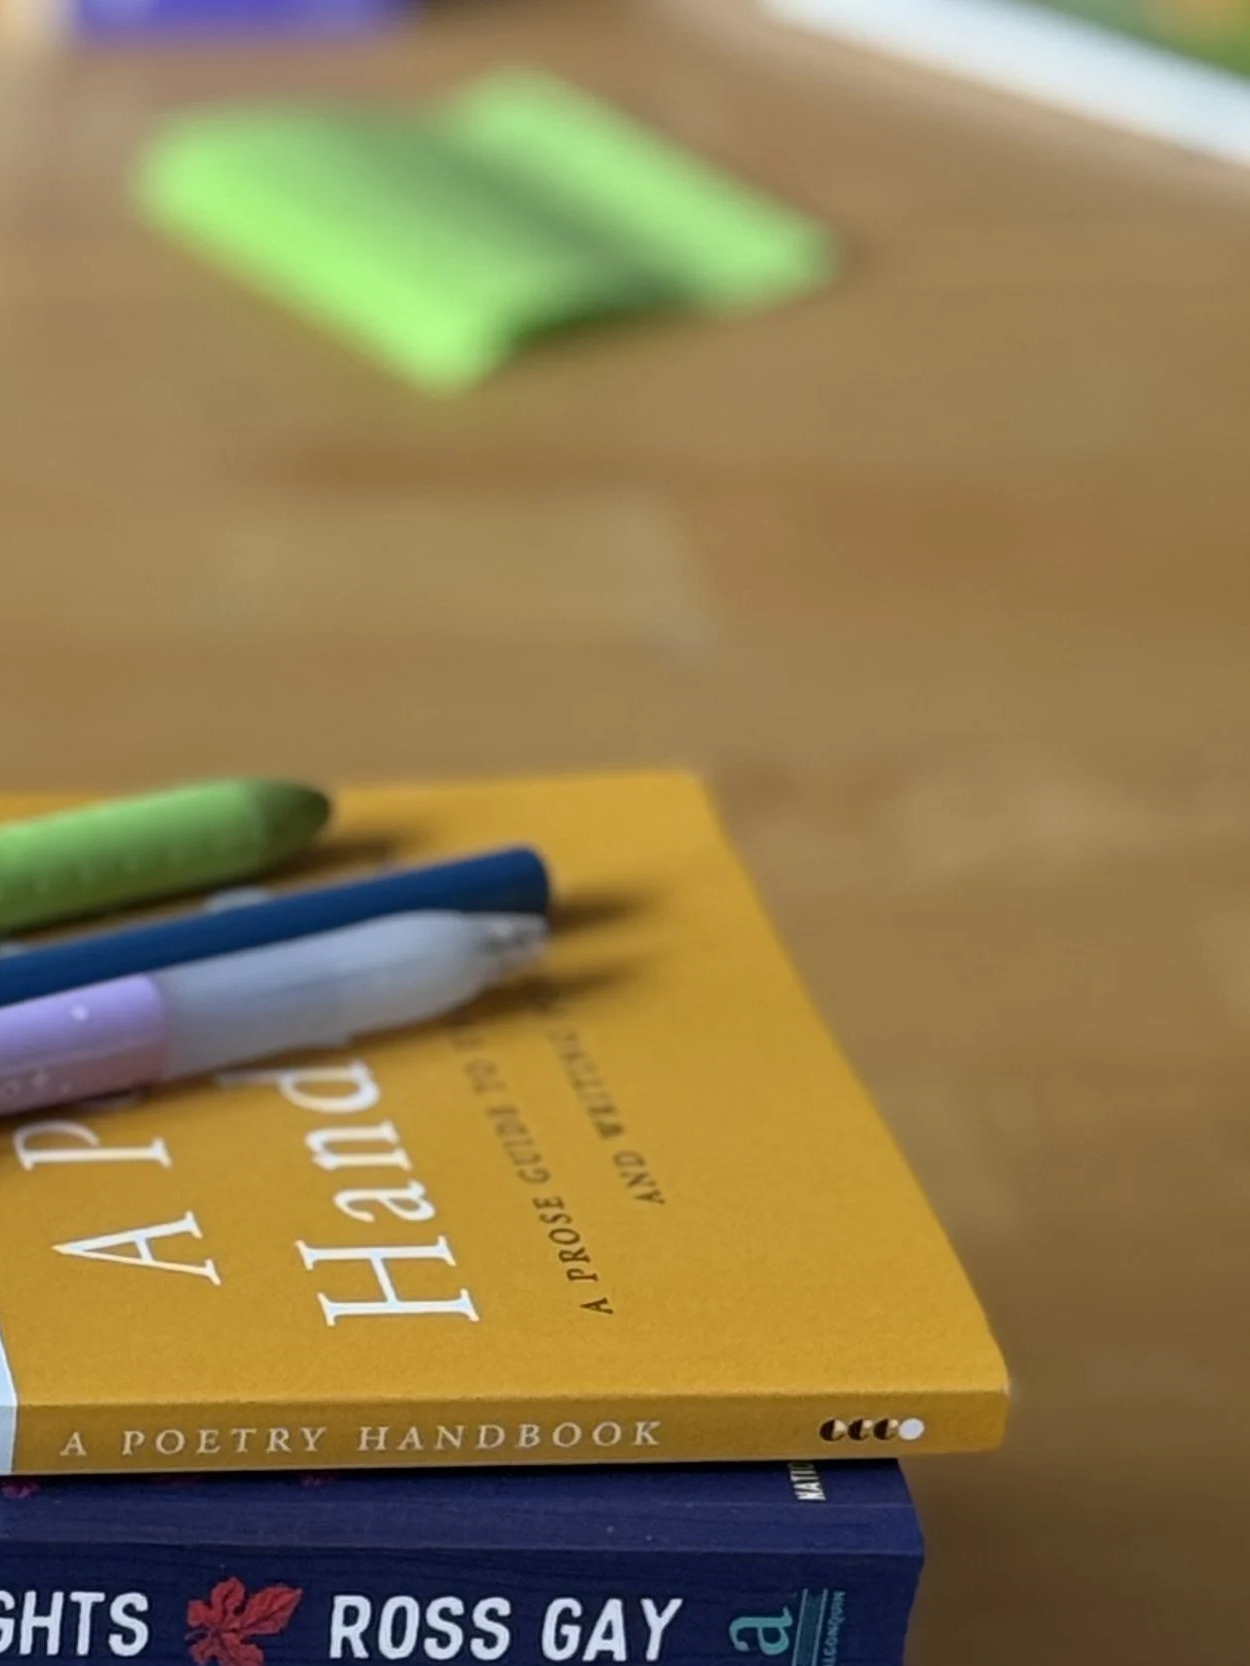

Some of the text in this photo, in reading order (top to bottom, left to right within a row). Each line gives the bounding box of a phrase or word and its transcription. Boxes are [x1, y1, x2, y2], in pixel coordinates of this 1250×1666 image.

[213, 1060, 480, 1327] Hand
[612, 1150, 666, 1206] AND
[51, 1211, 222, 1286] A
[532, 1195, 599, 1284] PROSE
[579, 1297, 614, 1316] A
[59, 1421, 661, 1458] A POETRY HANDBOOK
[328, 1595, 683, 1663] ROSS GAY
